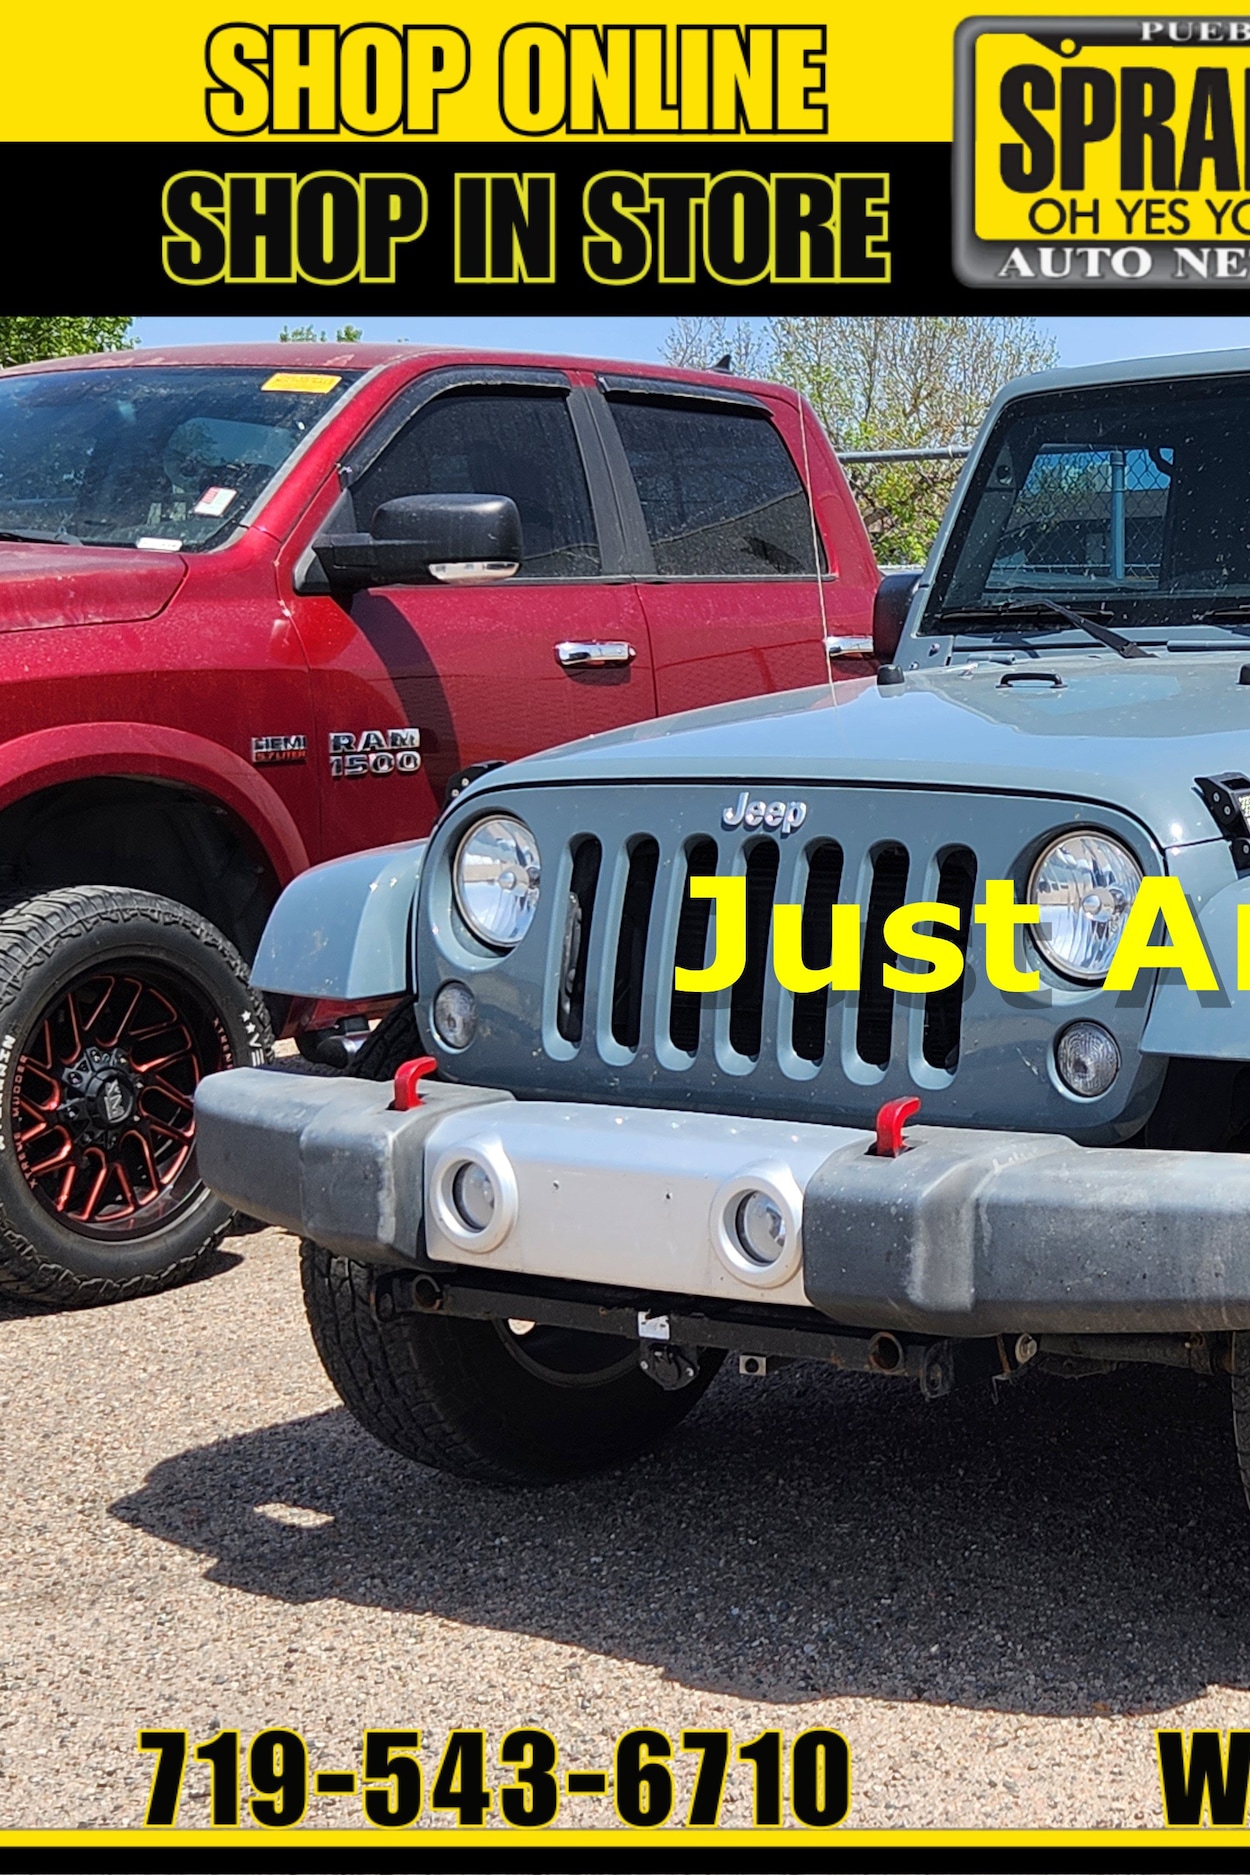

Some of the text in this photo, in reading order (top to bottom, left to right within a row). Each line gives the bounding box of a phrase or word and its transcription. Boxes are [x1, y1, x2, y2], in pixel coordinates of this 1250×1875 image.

[252, 735, 306, 751] HEMI
[329, 728, 421, 753] RAM
[330, 751, 421, 777] 1500
[722, 791, 807, 834] Jeep
